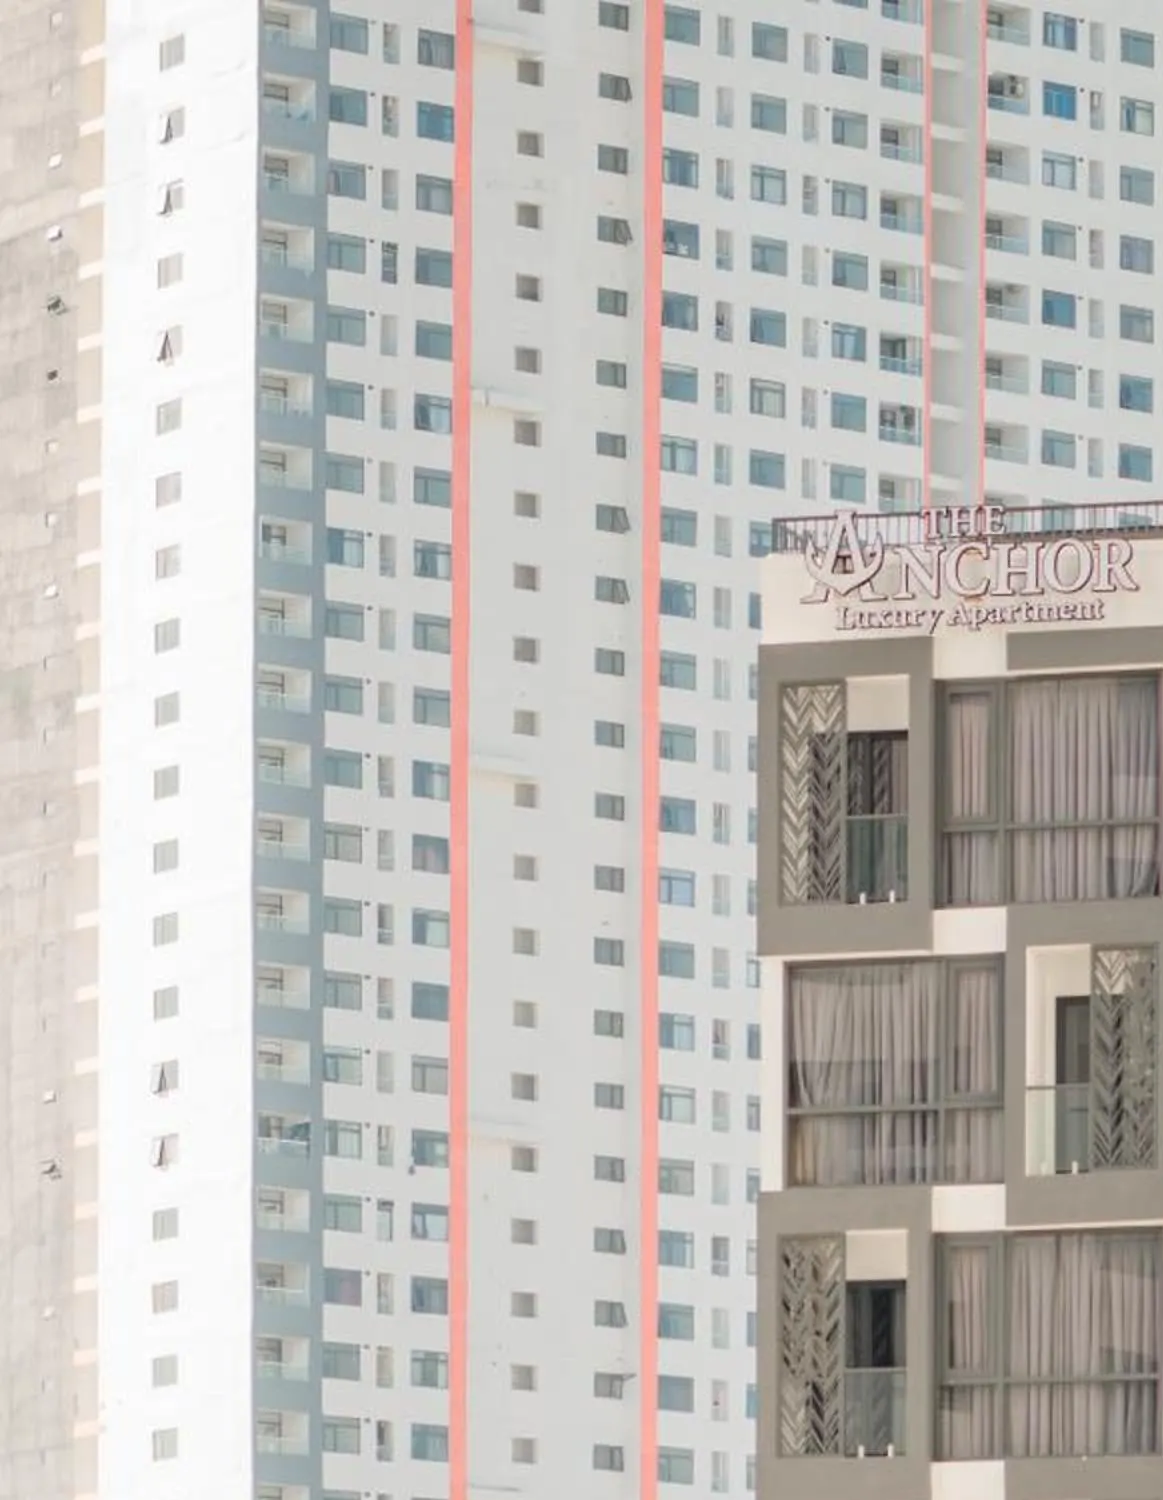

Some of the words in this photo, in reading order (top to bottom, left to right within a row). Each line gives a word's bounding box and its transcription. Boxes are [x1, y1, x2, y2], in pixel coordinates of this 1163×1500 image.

[921, 505, 1008, 540] THE
[800, 508, 1141, 604] ANCHOR
[836, 606, 946, 635] Luxury
[948, 598, 1106, 632] Apartment
